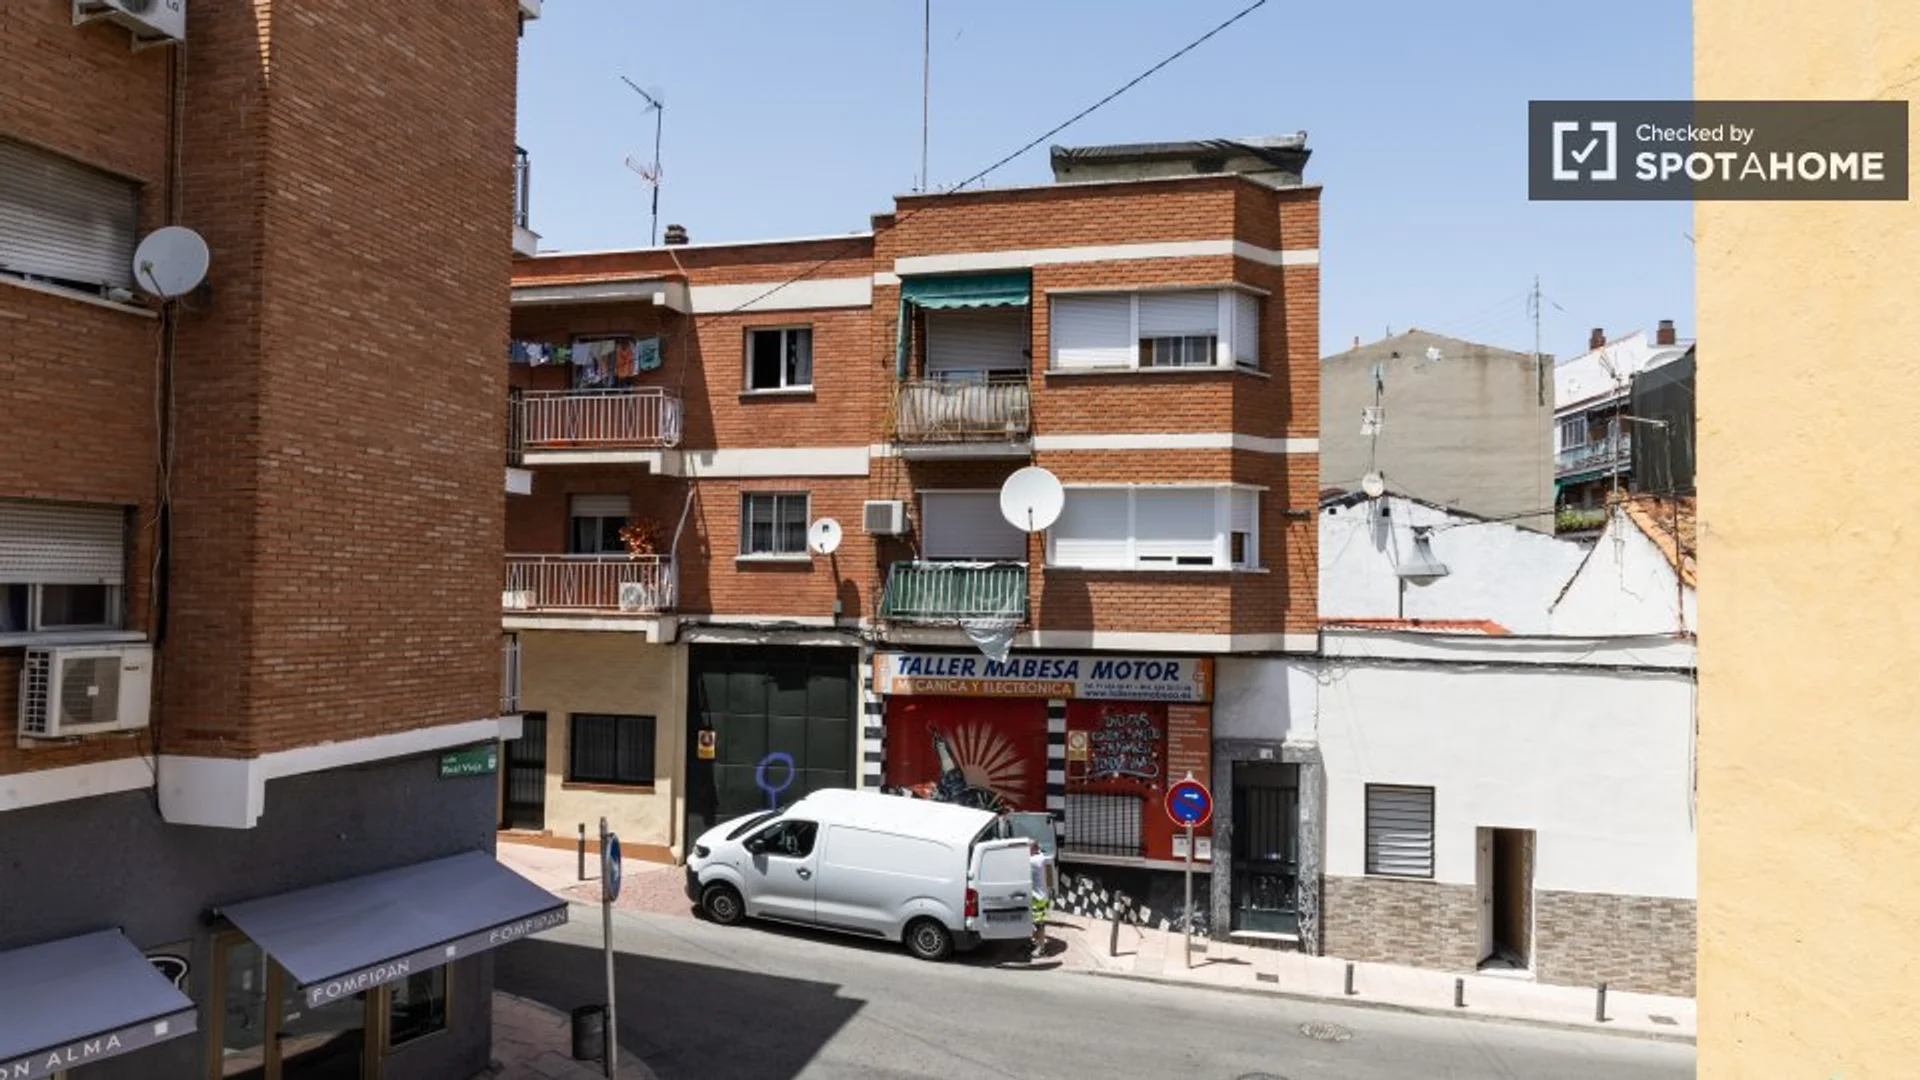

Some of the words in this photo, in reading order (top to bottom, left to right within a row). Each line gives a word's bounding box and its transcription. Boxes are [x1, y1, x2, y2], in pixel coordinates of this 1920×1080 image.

[899, 656, 976, 676] TALLER
[984, 659, 1080, 680] MABESA
[1091, 661, 1180, 681] MOTOR
[45, 1034, 123, 1069] ALMA
